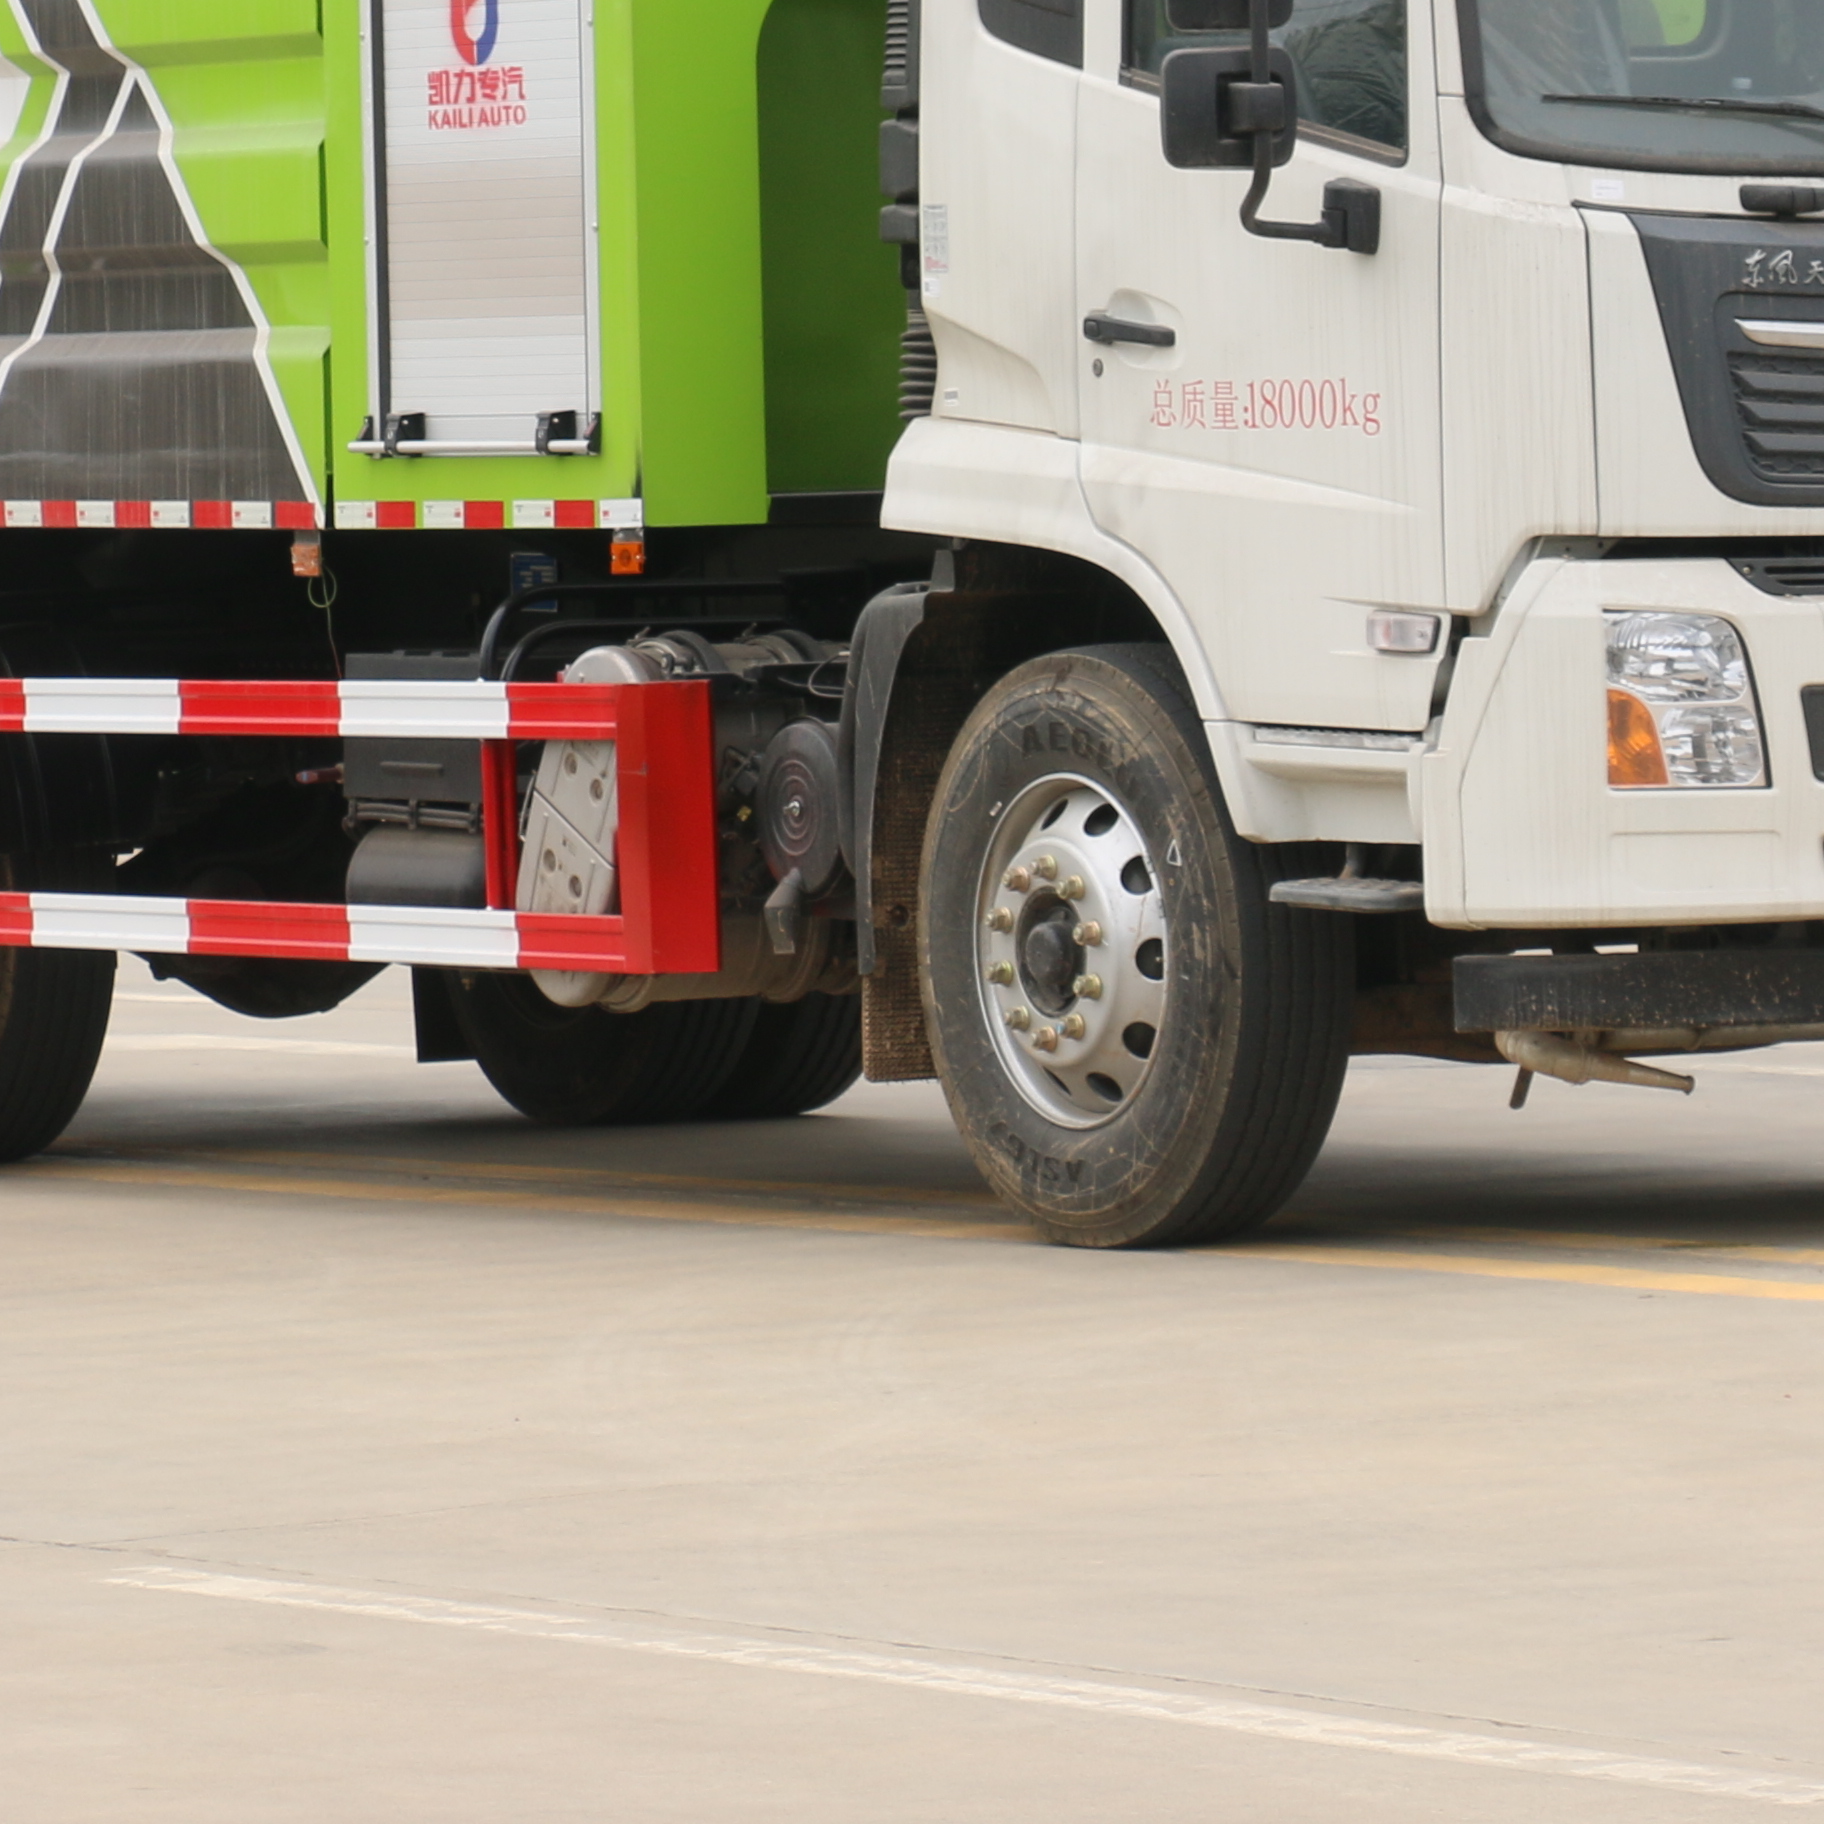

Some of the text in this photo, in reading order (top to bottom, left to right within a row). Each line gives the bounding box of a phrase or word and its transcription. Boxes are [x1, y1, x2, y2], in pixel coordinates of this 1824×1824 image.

[428, 66, 526, 105] 凯力专汽
[428, 105, 526, 130] KAILI AUTO
